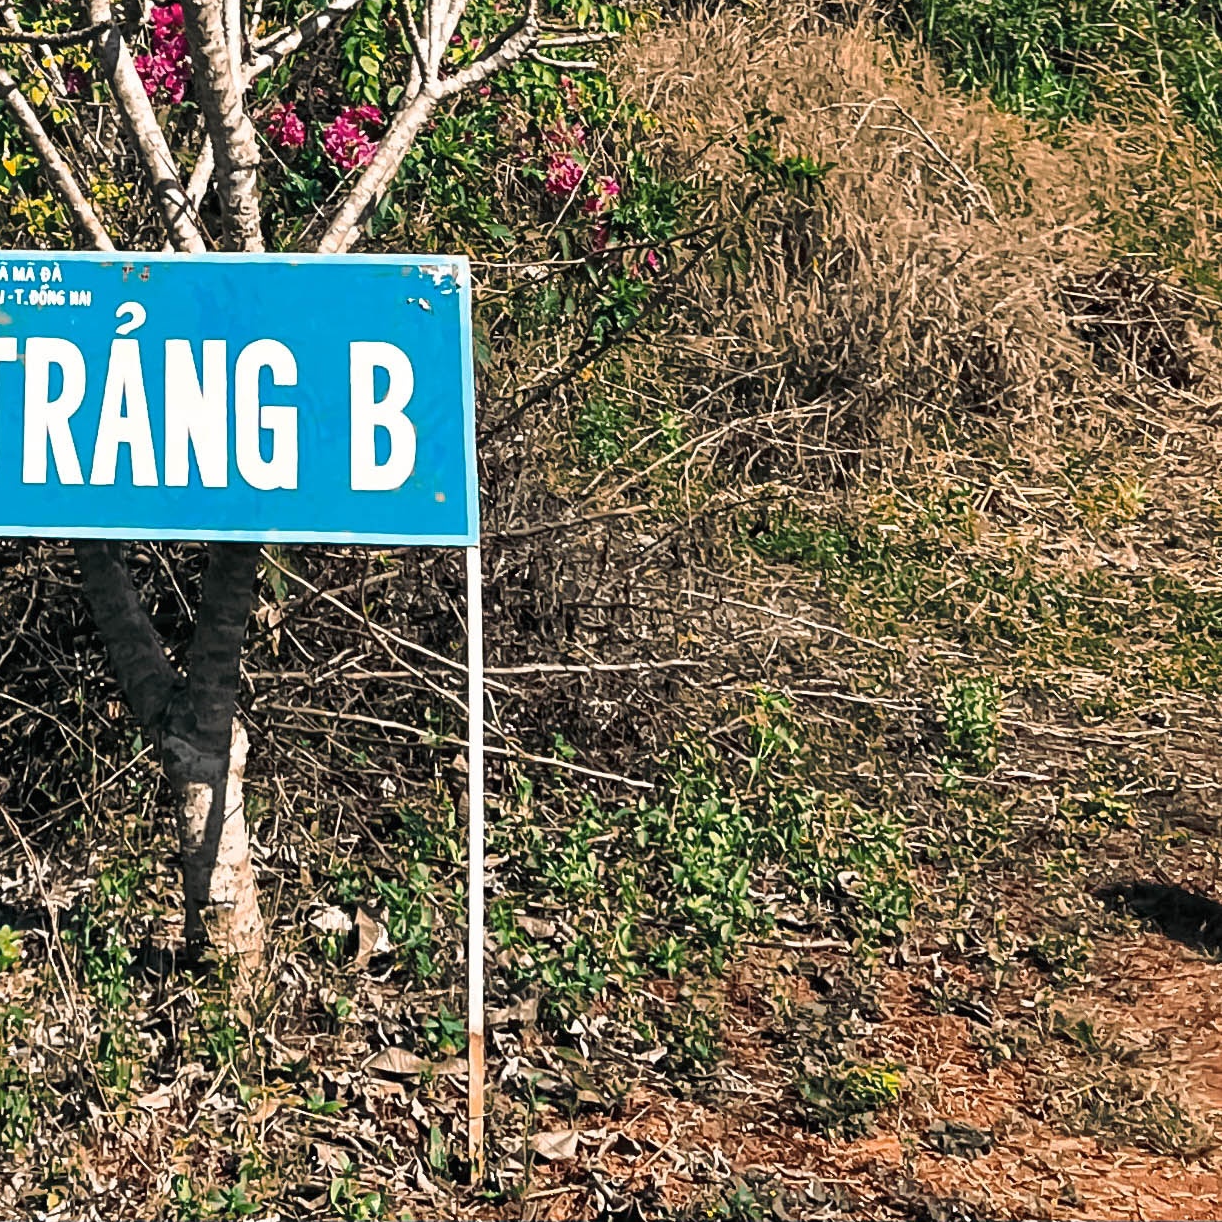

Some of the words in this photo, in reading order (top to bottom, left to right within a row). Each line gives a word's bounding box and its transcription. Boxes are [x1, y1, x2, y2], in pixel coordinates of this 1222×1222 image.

[12, 261, 36, 282] MÃ
[39, 261, 63, 283] ĐÀ
[69, 289, 92, 307] NAI
[349, 341, 418, 491] B
